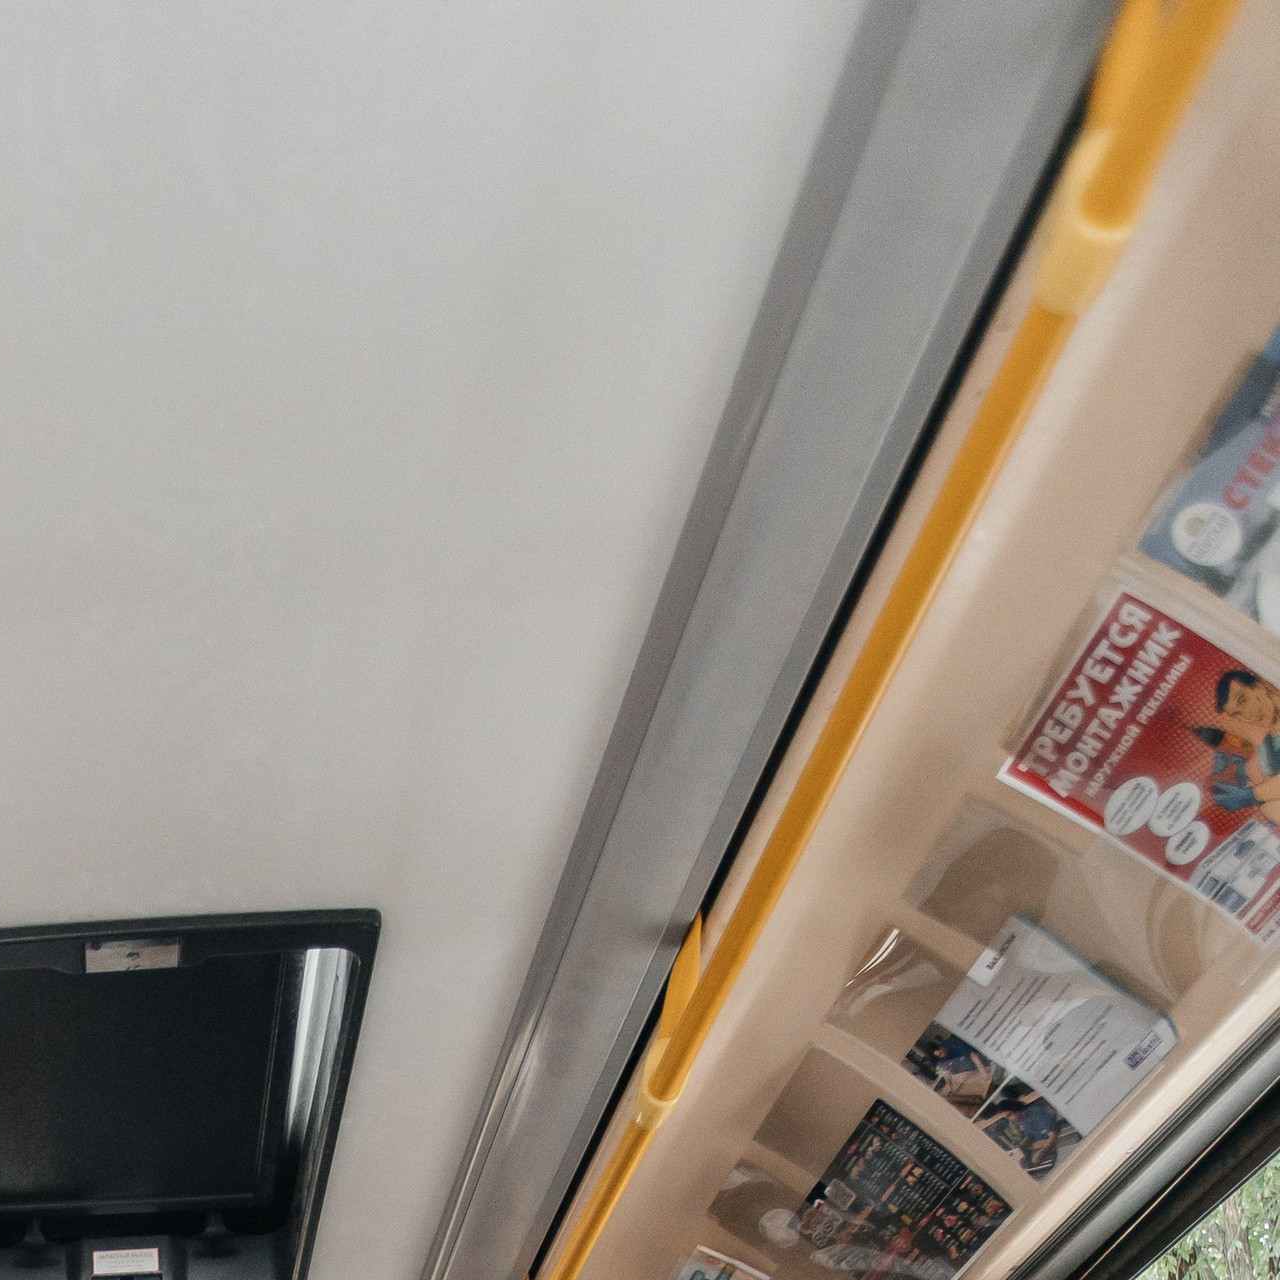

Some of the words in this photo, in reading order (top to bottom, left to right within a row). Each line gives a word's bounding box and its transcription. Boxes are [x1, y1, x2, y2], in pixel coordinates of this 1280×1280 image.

[1017, 602, 1152, 776] ТРЕБУЕТСЯ
[1048, 621, 1181, 798] МОНТАЖНИК
[1085, 724, 1142, 798] НАРУЖНОЙ
[1135, 653, 1193, 725] РЕКЛАМЫ
